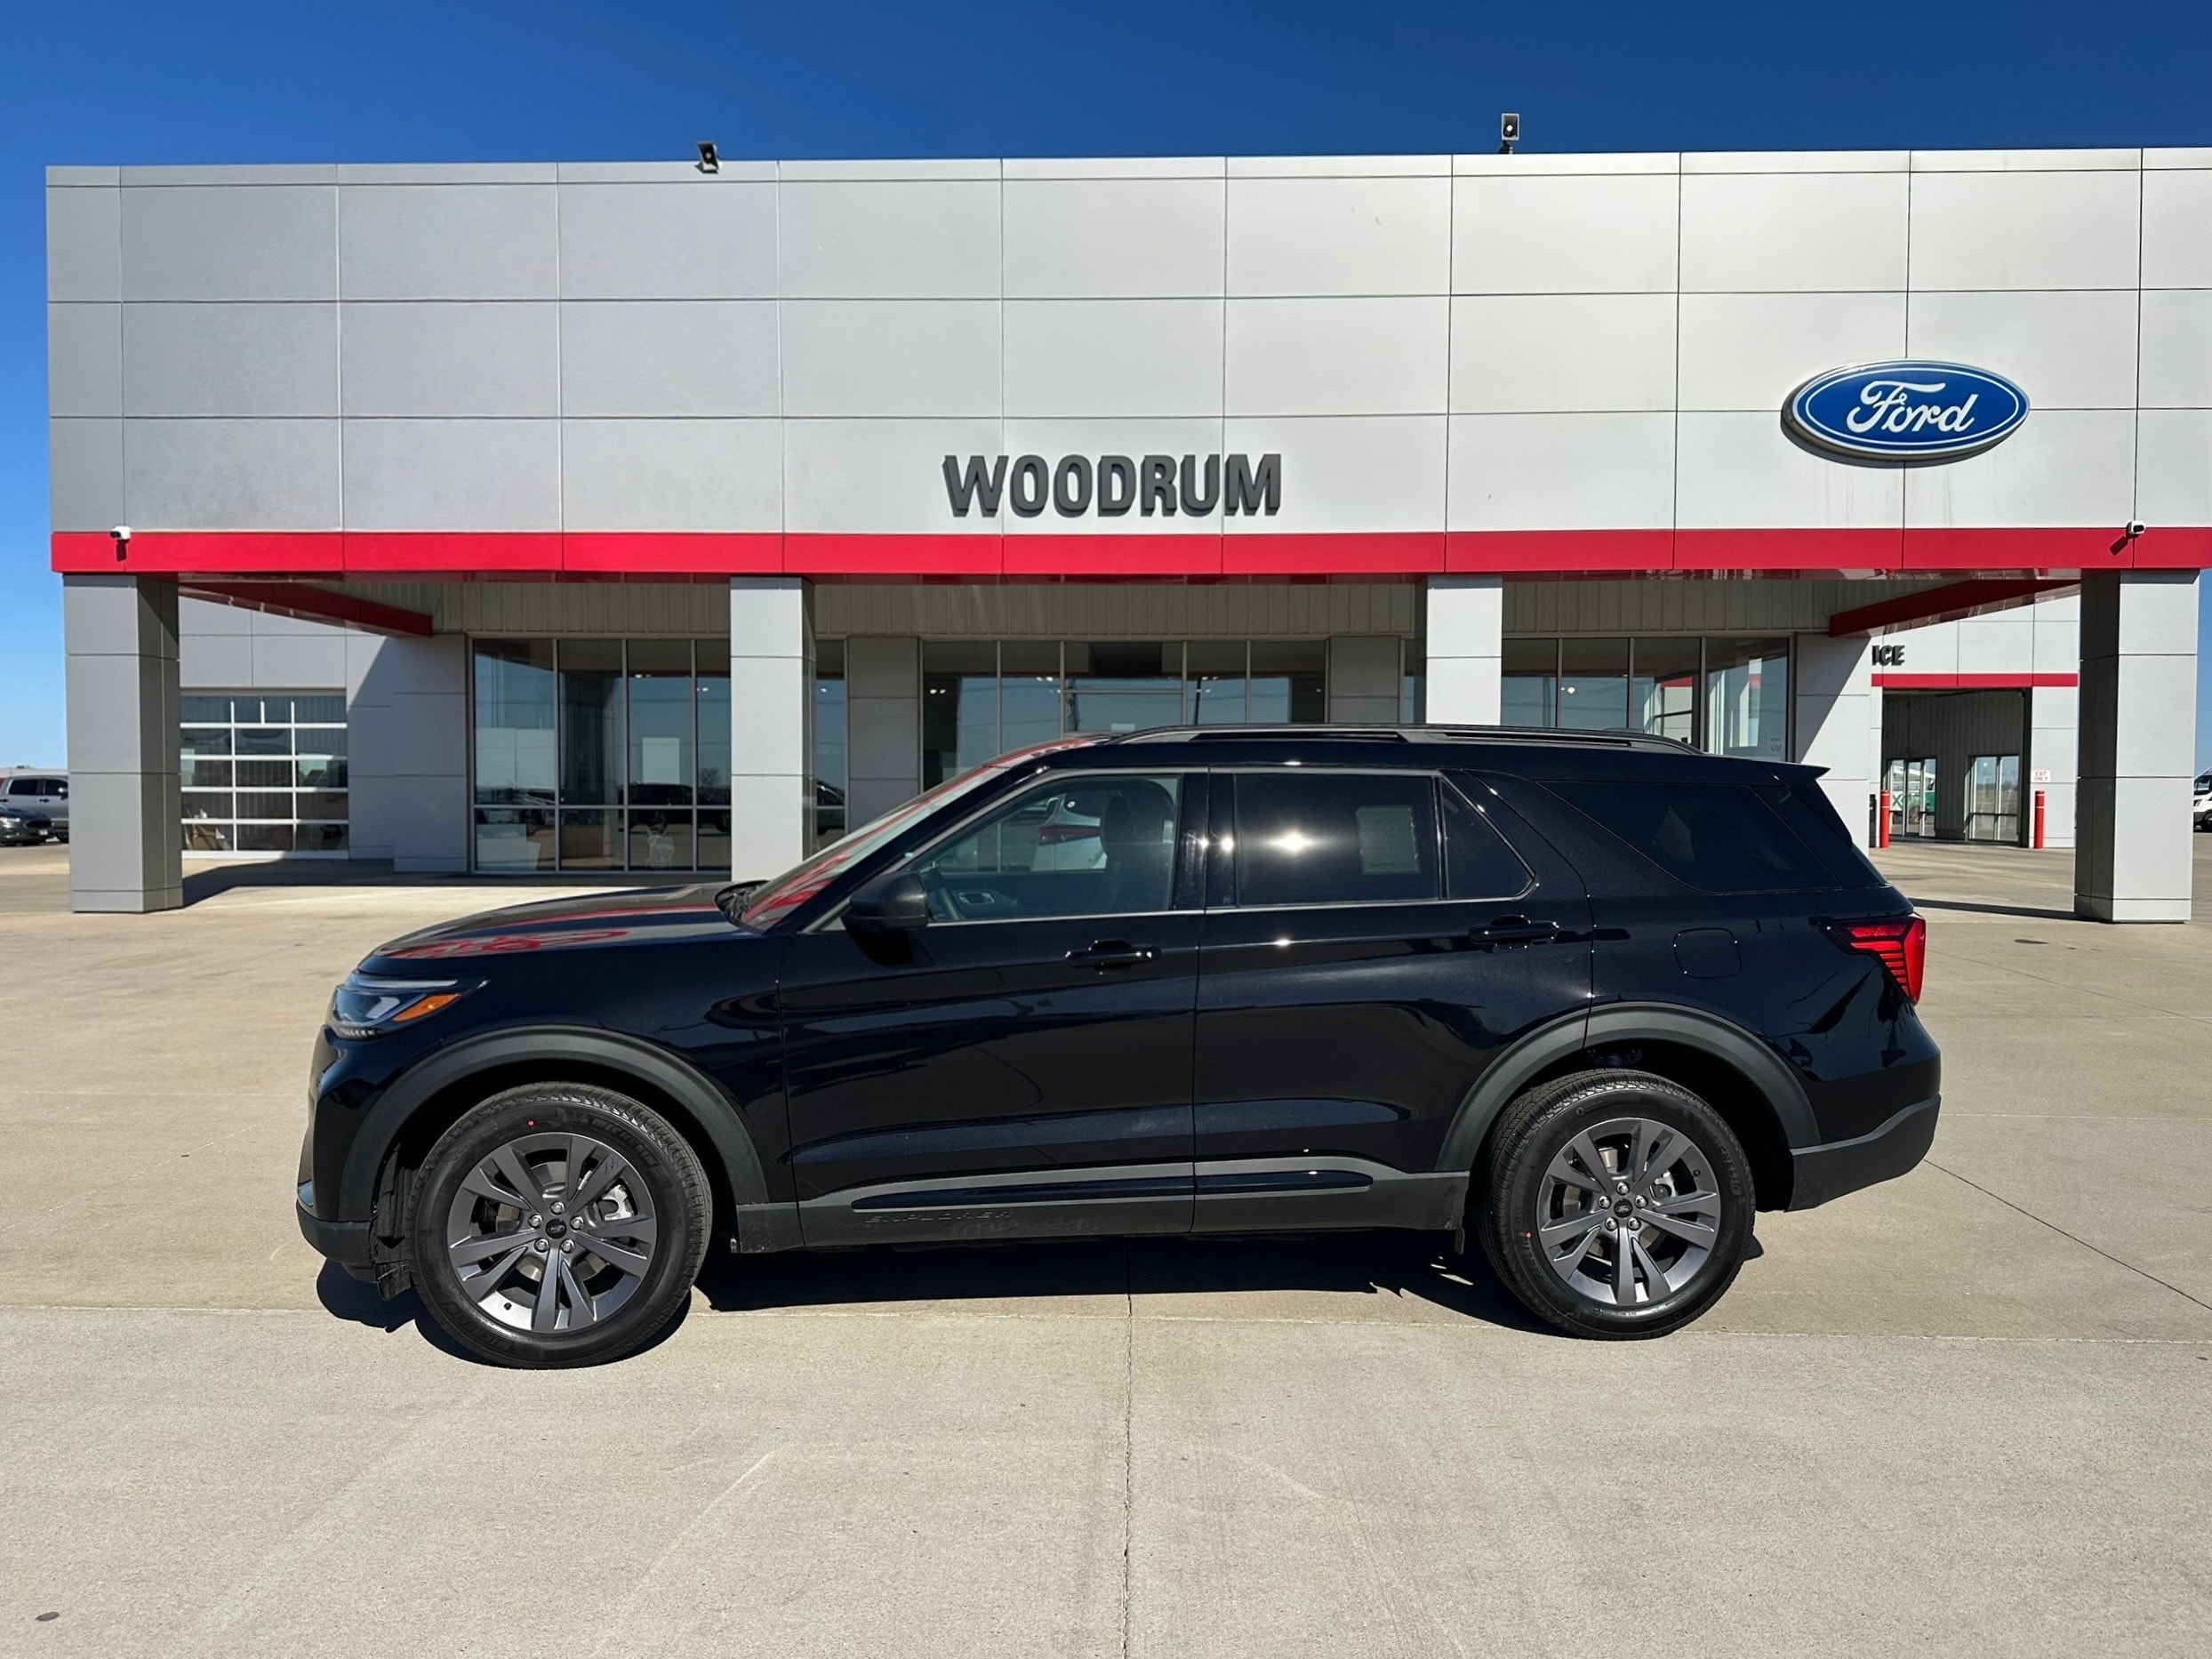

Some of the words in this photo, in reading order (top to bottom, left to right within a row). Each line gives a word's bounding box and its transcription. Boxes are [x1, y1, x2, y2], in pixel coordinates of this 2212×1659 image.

[1847, 381, 1978, 433] Ford
[942, 454, 1281, 517] WOODRUM
[1871, 645, 1904, 666] ICE
[591, 1118, 659, 1167] MICHELIN
